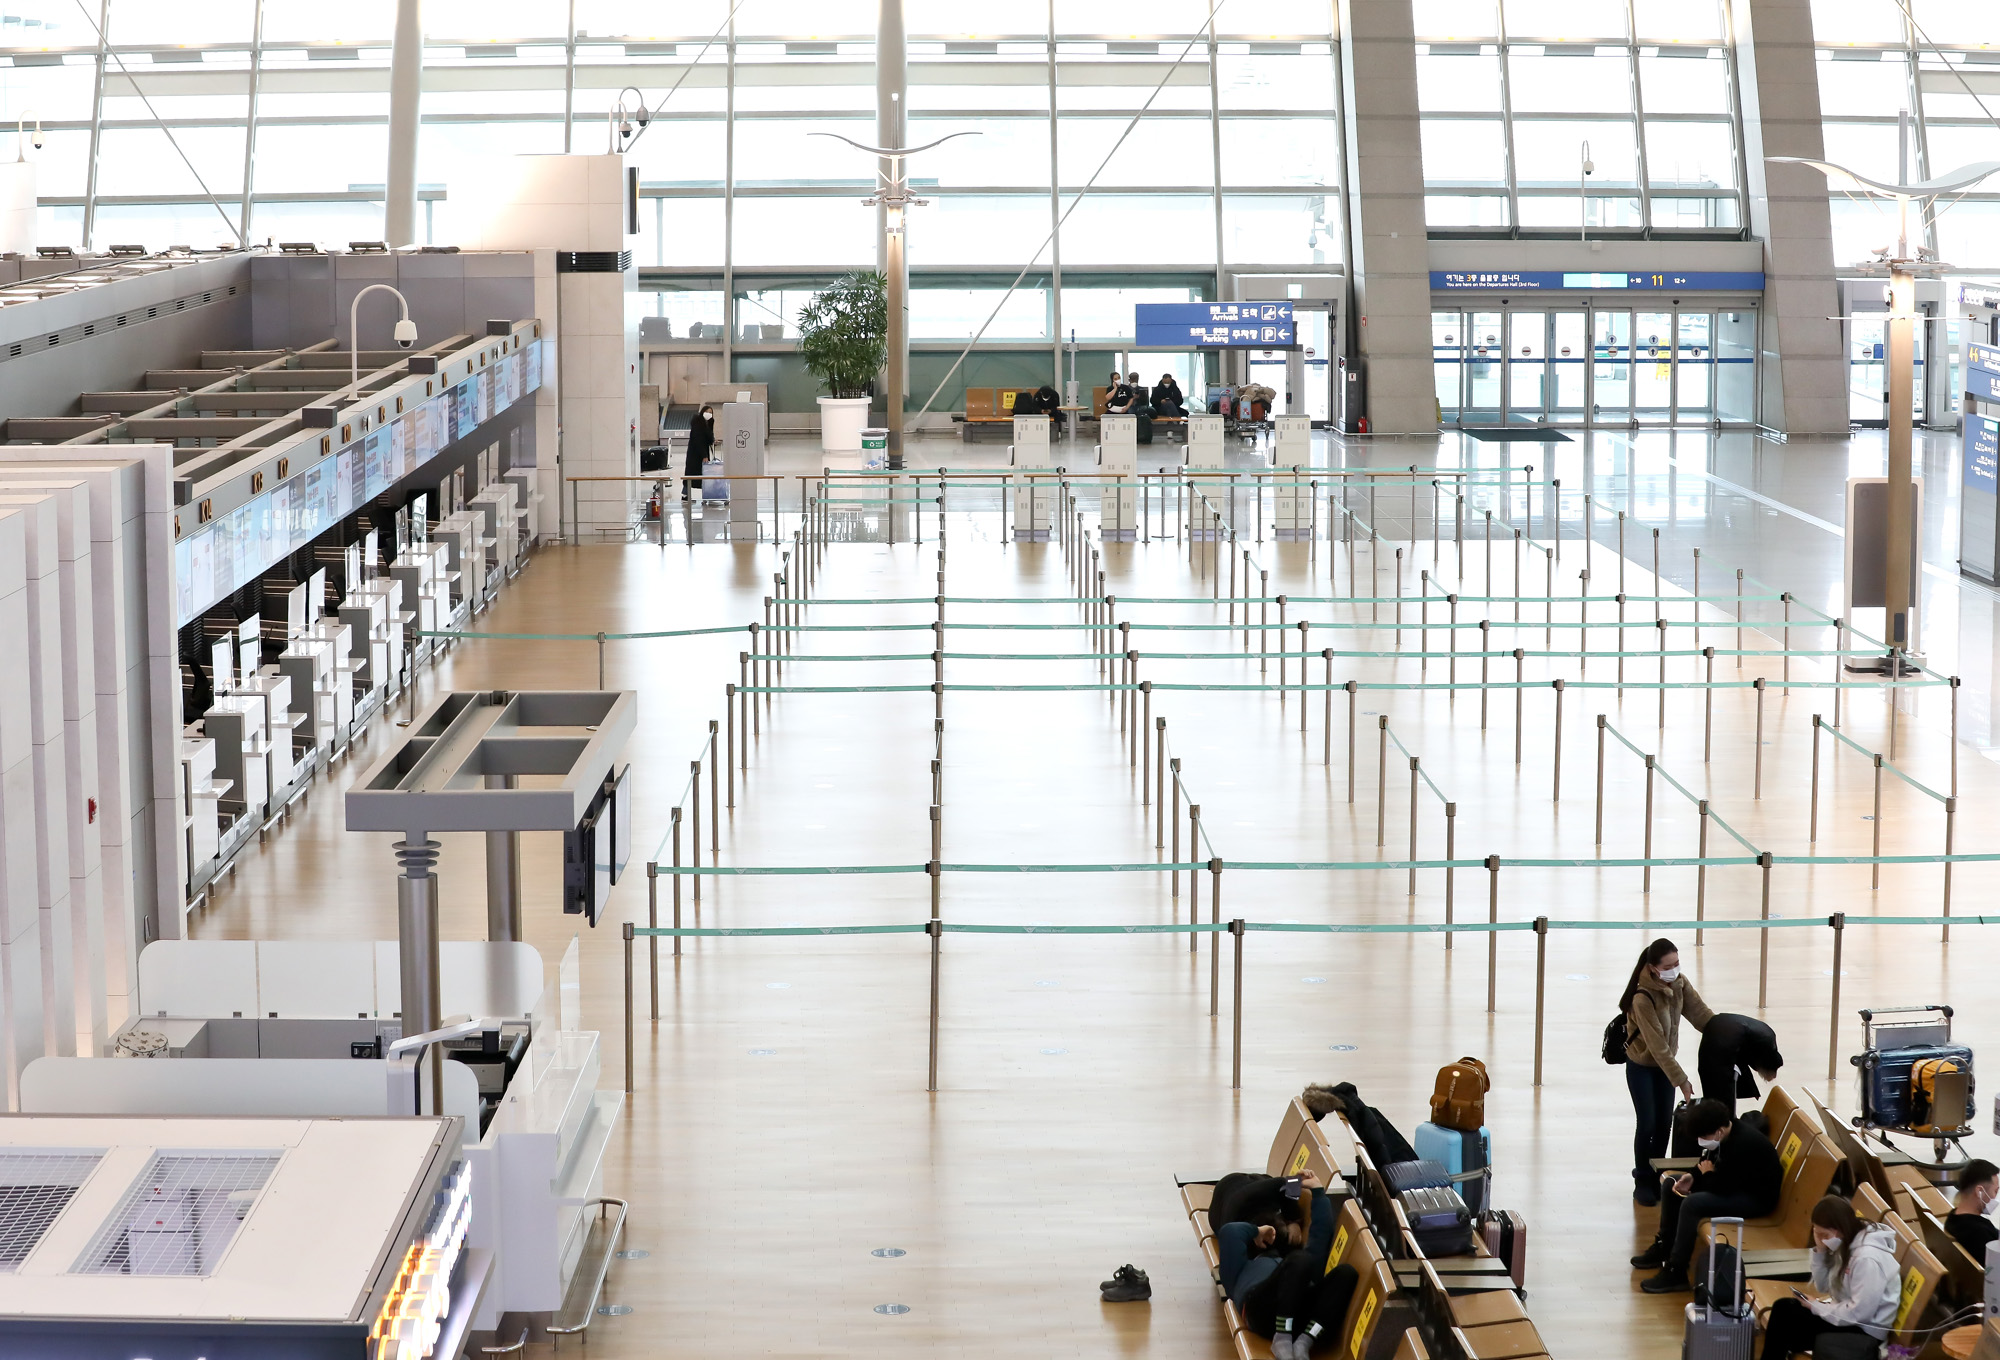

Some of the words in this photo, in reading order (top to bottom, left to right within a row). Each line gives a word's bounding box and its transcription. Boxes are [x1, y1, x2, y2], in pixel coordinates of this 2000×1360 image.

[1446, 274, 1465, 282] 여기는
[1467, 274, 1478, 282] 3층
[1651, 274, 1663, 286] 11
[1202, 335, 1229, 344] Parking
[198, 498, 212, 524] K14
